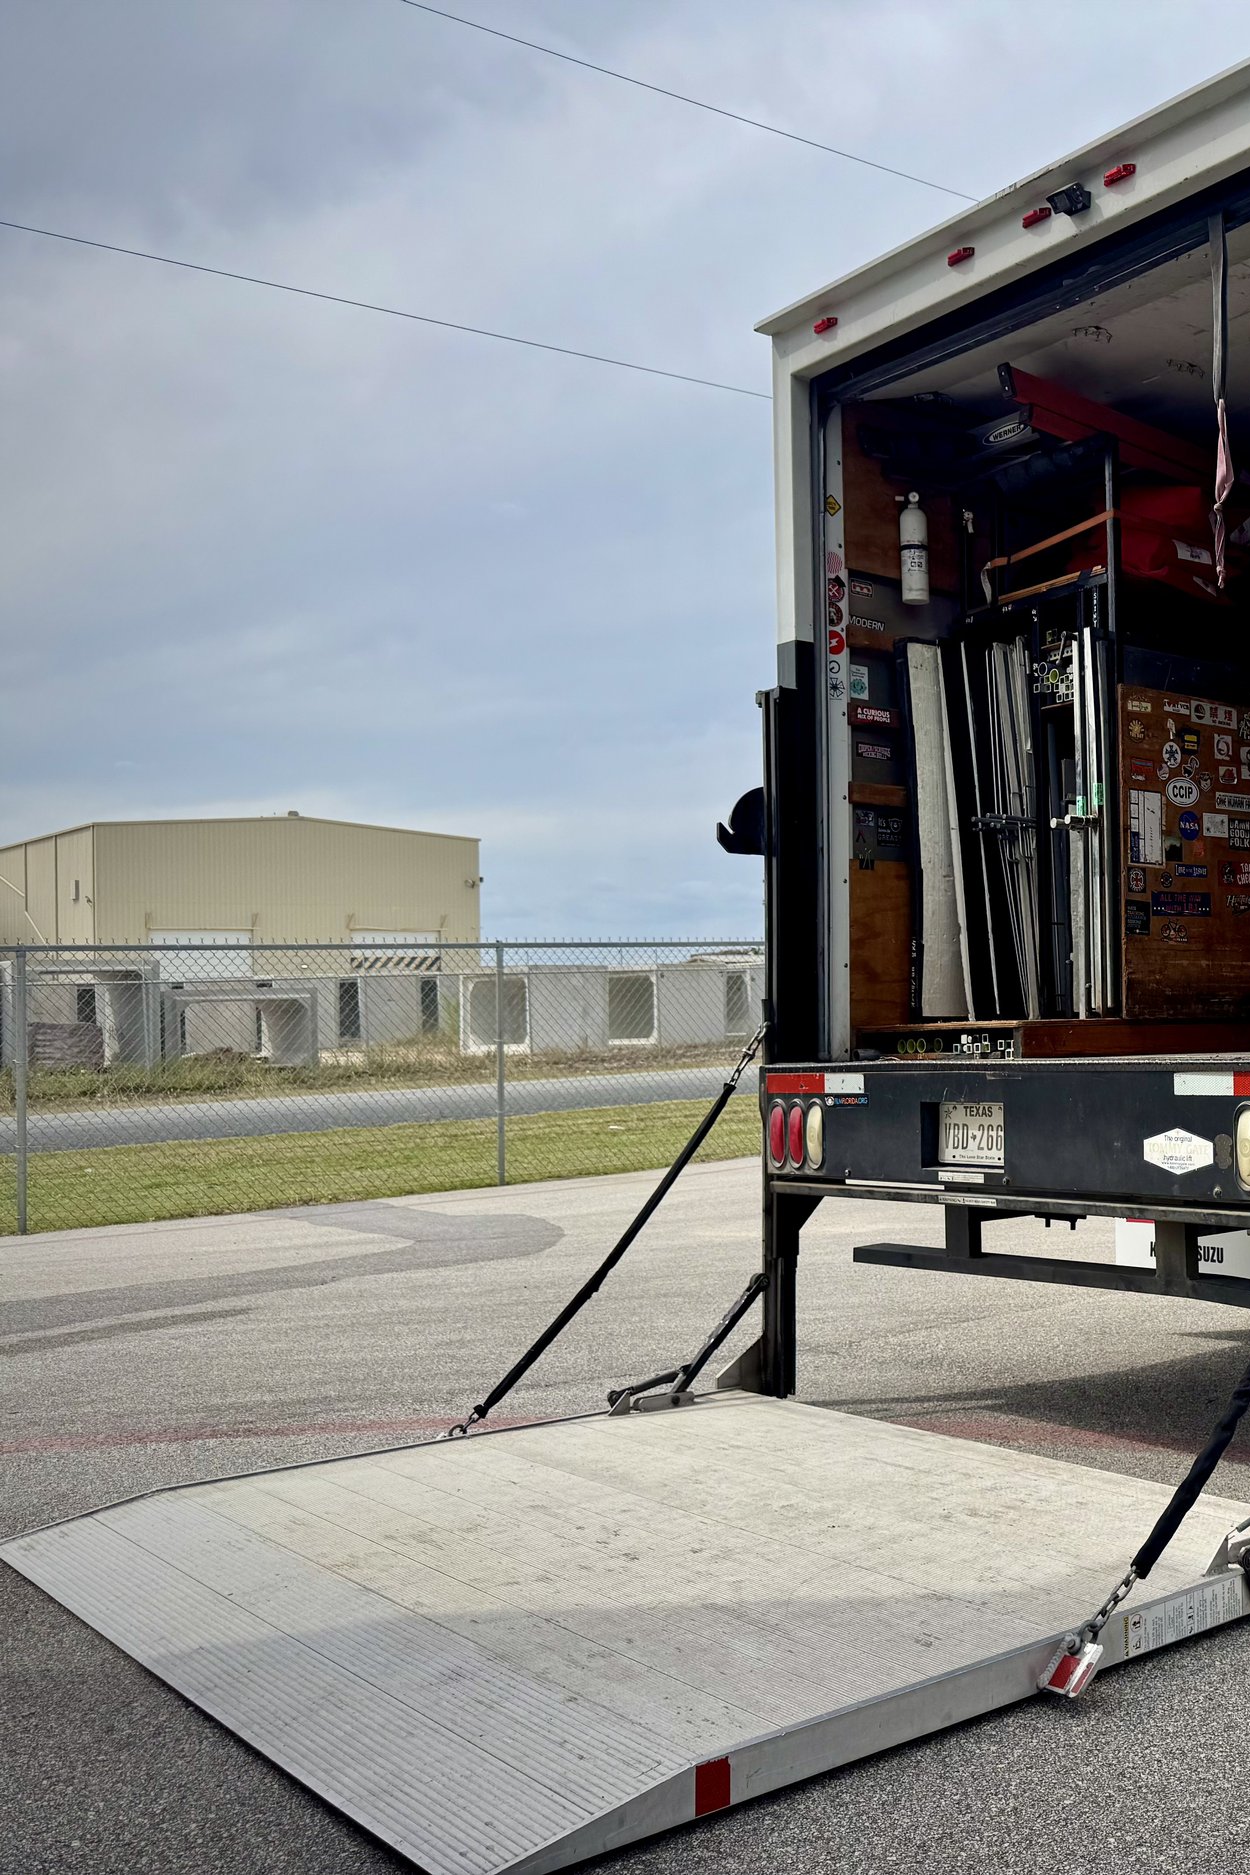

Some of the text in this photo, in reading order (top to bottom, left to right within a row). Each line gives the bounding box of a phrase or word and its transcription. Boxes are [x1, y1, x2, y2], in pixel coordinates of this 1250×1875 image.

[993, 424, 1022, 441] WERNER
[849, 615, 885, 631] MODERN
[1172, 785, 1193, 799] CCIP
[1180, 821, 1199, 831] NASA
[1229, 839, 1250, 849] FOLK
[963, 1106, 993, 1118] TEXAS
[944, 1123, 969, 1150] VBD
[1197, 1246, 1224, 1264] SUZU
